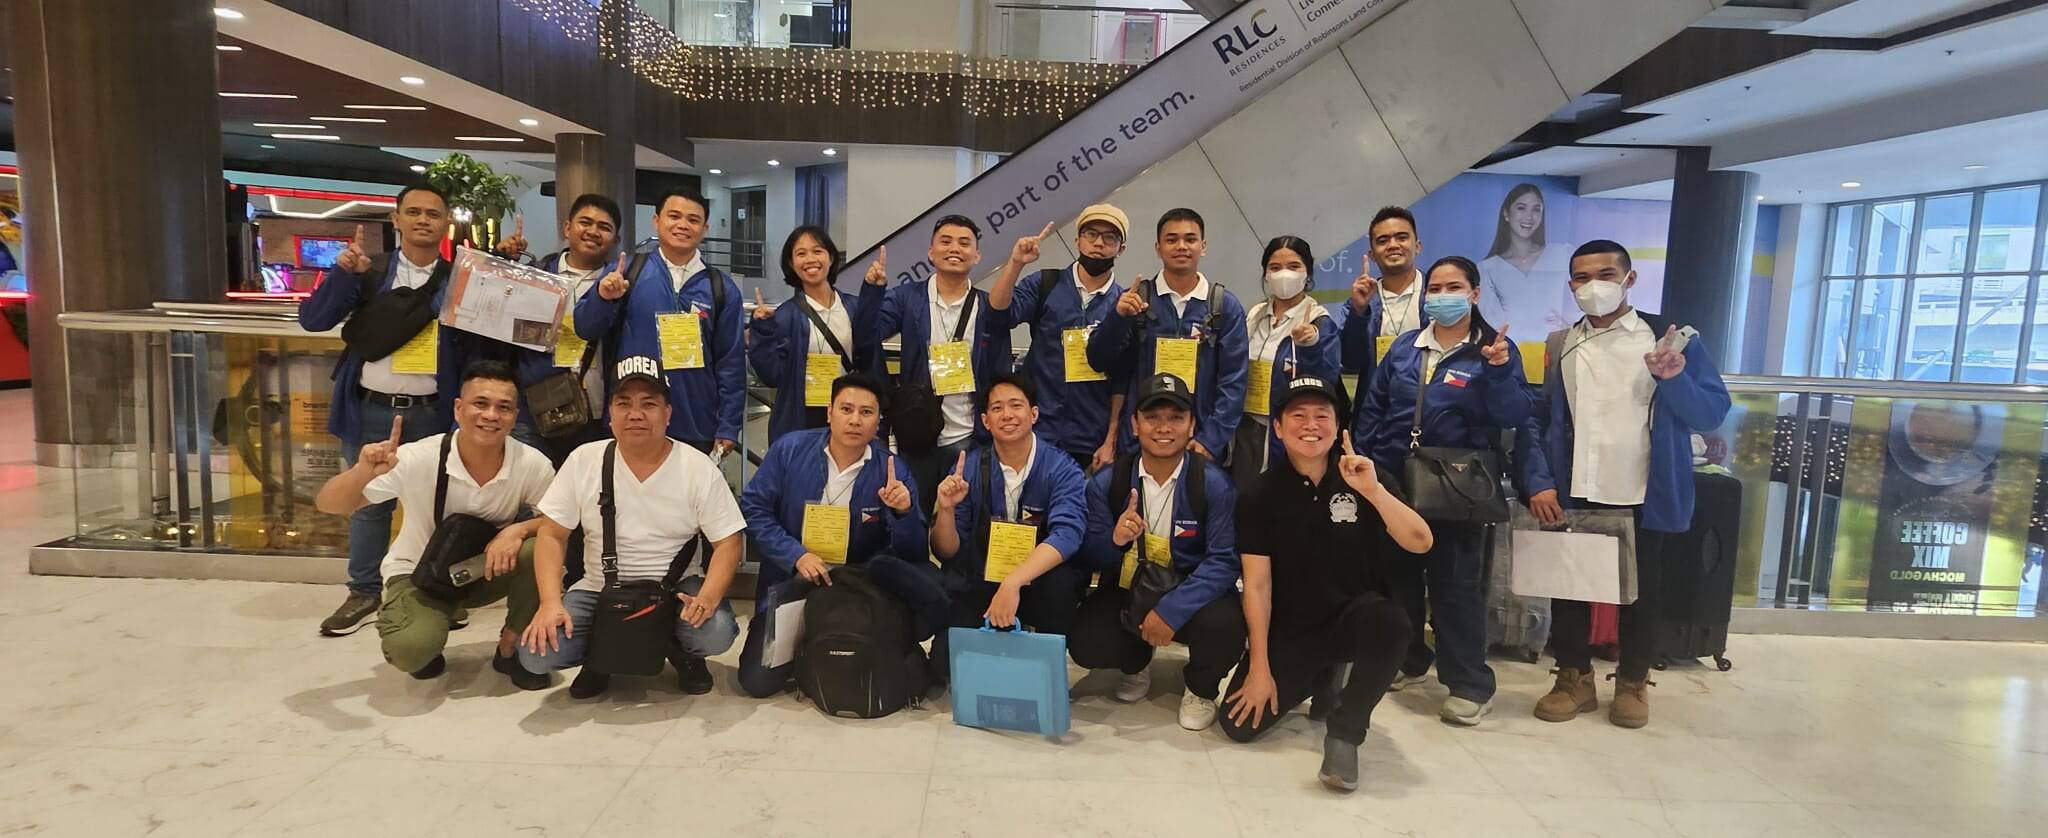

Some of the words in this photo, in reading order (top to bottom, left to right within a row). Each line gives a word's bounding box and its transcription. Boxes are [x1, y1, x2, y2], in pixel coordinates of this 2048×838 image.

[1306, 0, 1343, 22] Conne
[1212, 8, 1277, 64] RLC
[1229, 36, 1286, 76] RESIDENCES
[1239, 65, 1277, 92] Residential
[1276, 47, 1304, 69] Division
[1304, 40, 1312, 50] of
[1311, 18, 1350, 46] Robinsons
[1348, 6, 1366, 21] Land
[986, 185, 1042, 235] part
[1044, 161, 1070, 192] of
[1071, 137, 1118, 172] the
[1119, 90, 1195, 141] team.
[617, 355, 659, 380] KOREA
